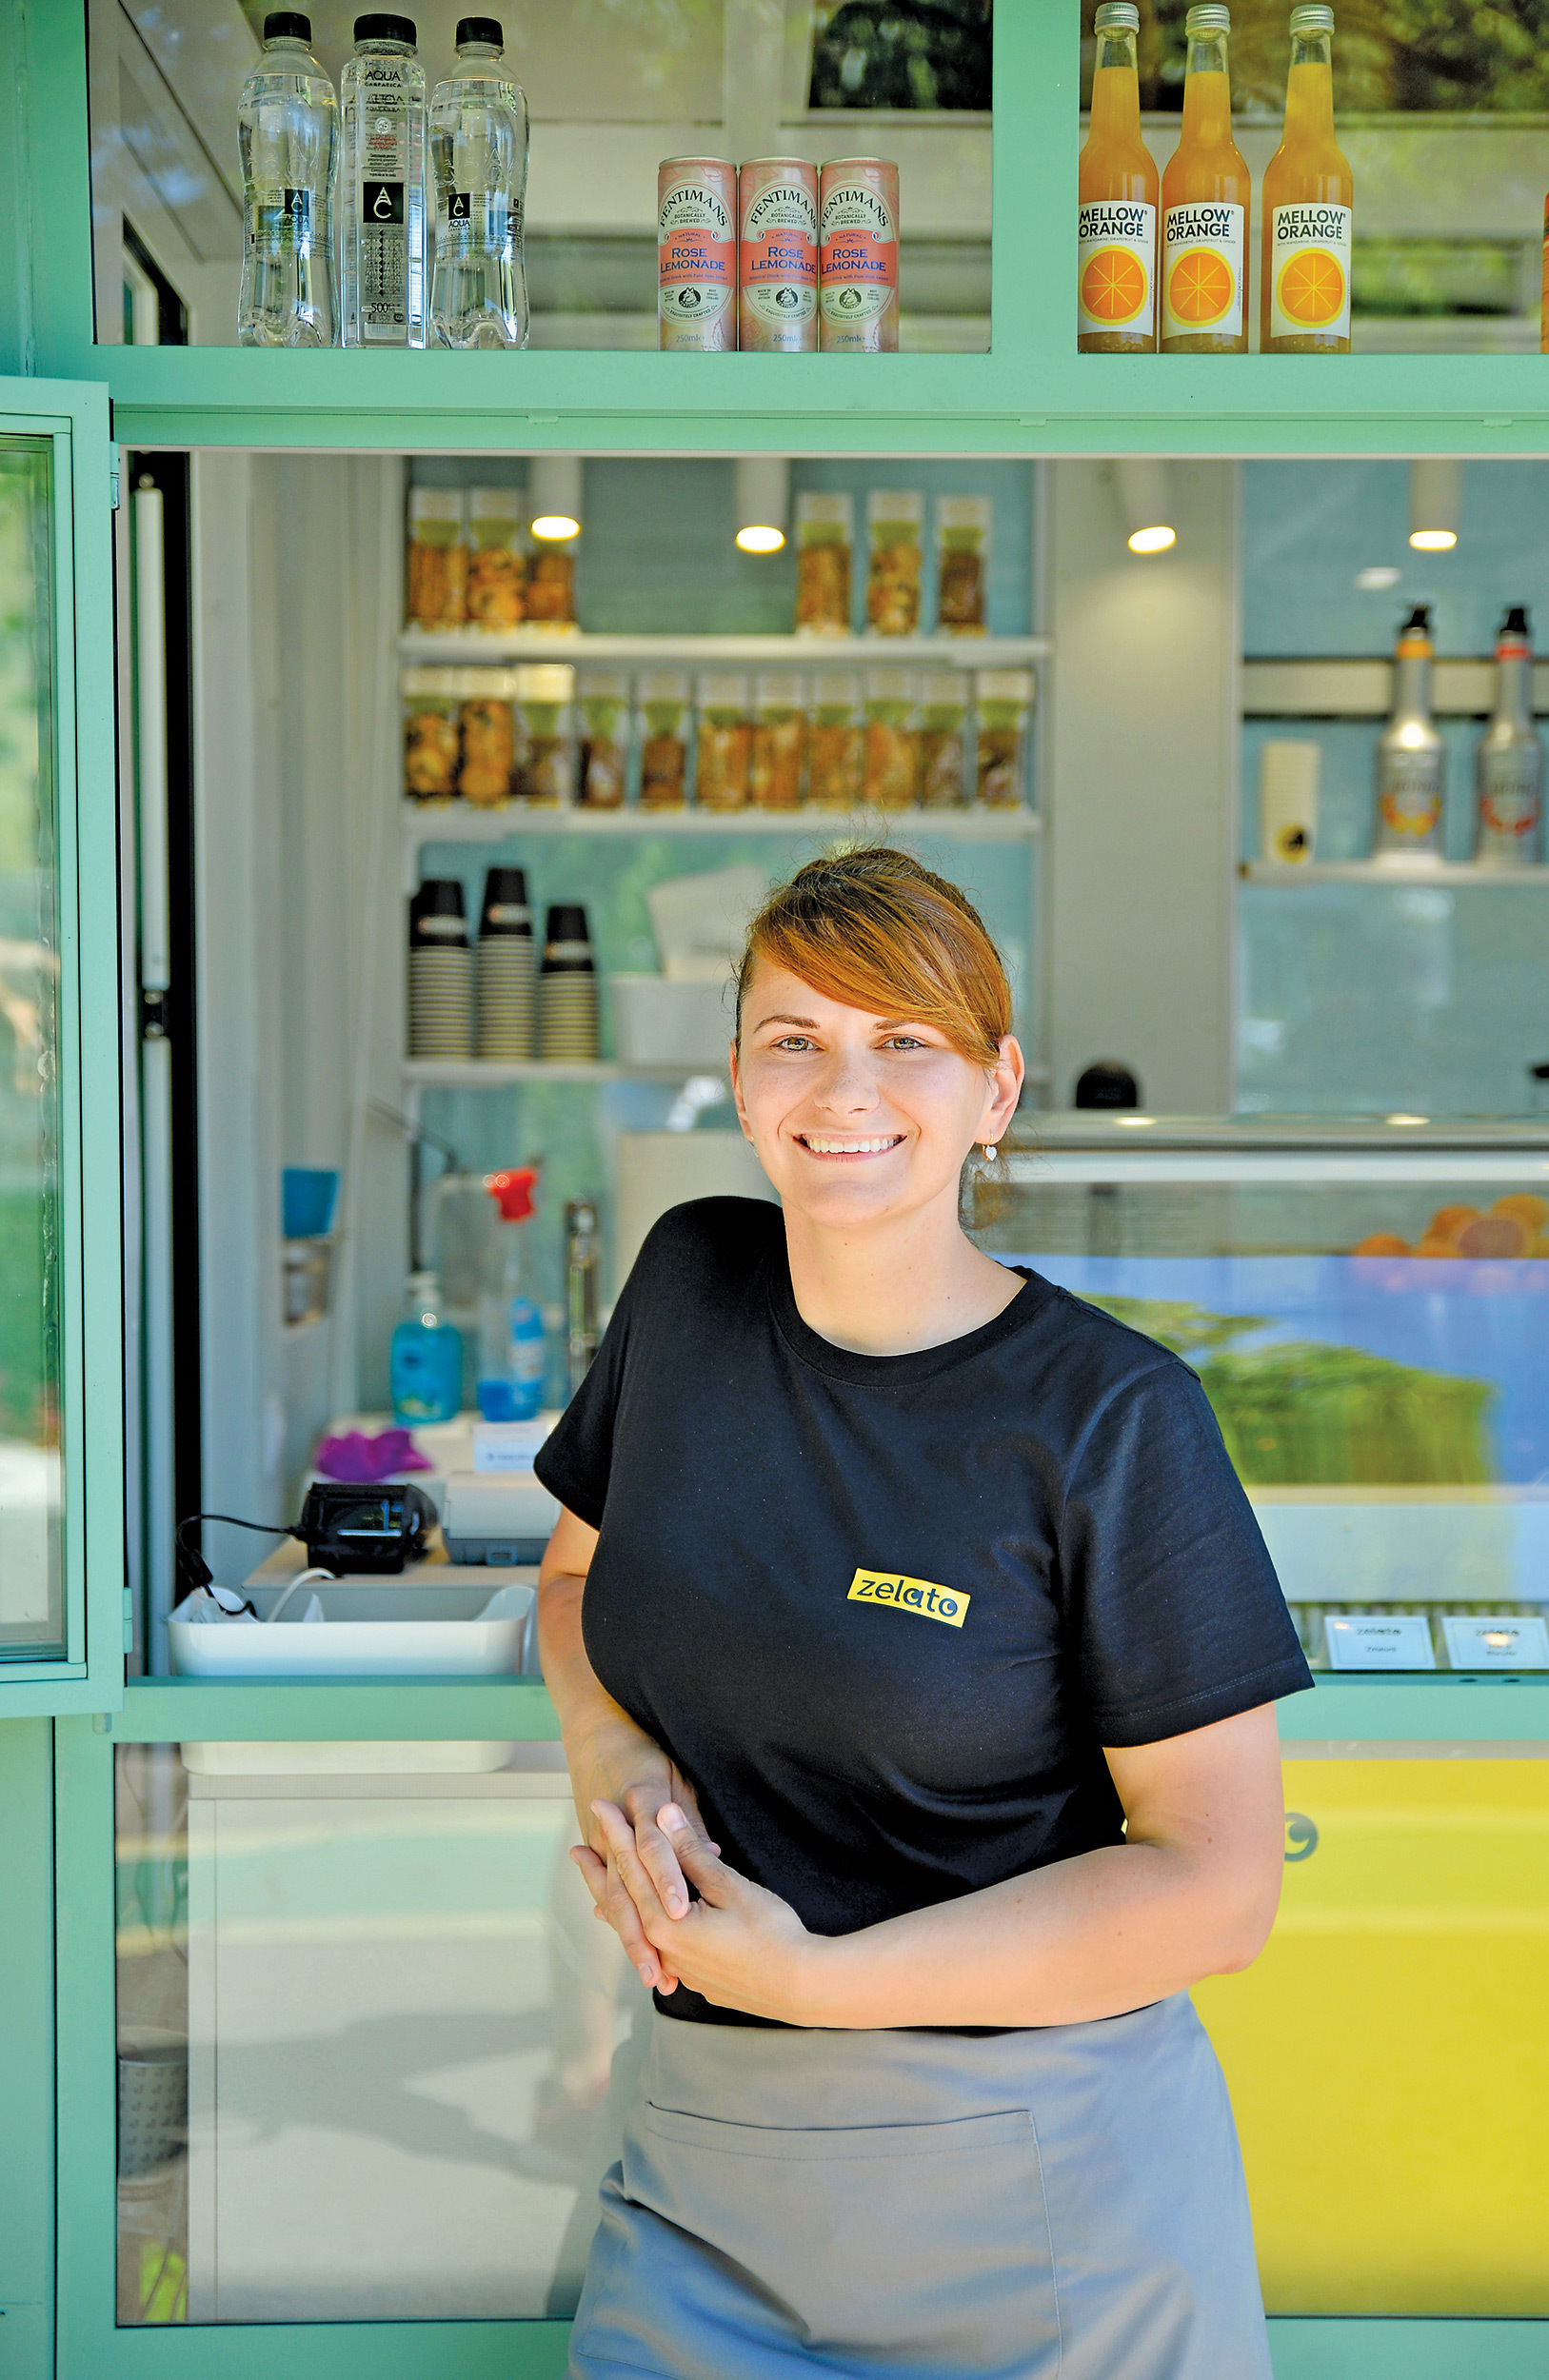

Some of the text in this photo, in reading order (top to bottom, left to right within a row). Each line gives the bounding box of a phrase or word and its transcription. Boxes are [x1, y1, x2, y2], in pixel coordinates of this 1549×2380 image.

[365, 70, 401, 81] AQUA
[660, 189, 727, 228] FENTIMANS
[750, 189, 816, 229] FENTIMANS
[822, 190, 889, 228] FENTIMANS
[285, 215, 309, 225] AQUA
[448, 219, 470, 228] AQUA
[1079, 222, 1143, 238] ORANGE
[1166, 223, 1230, 242] ORANGE
[1278, 224, 1342, 240] ORANGE
[671, 248, 707, 259] ROSE
[767, 247, 804, 259] ROSE
[832, 248, 868, 260] ROSE
[660, 260, 725, 273] LEMONADE
[751, 259, 816, 274] LEMONADE
[822, 260, 886, 274] LEMONADE
[856, 1579, 958, 1616] zelato
